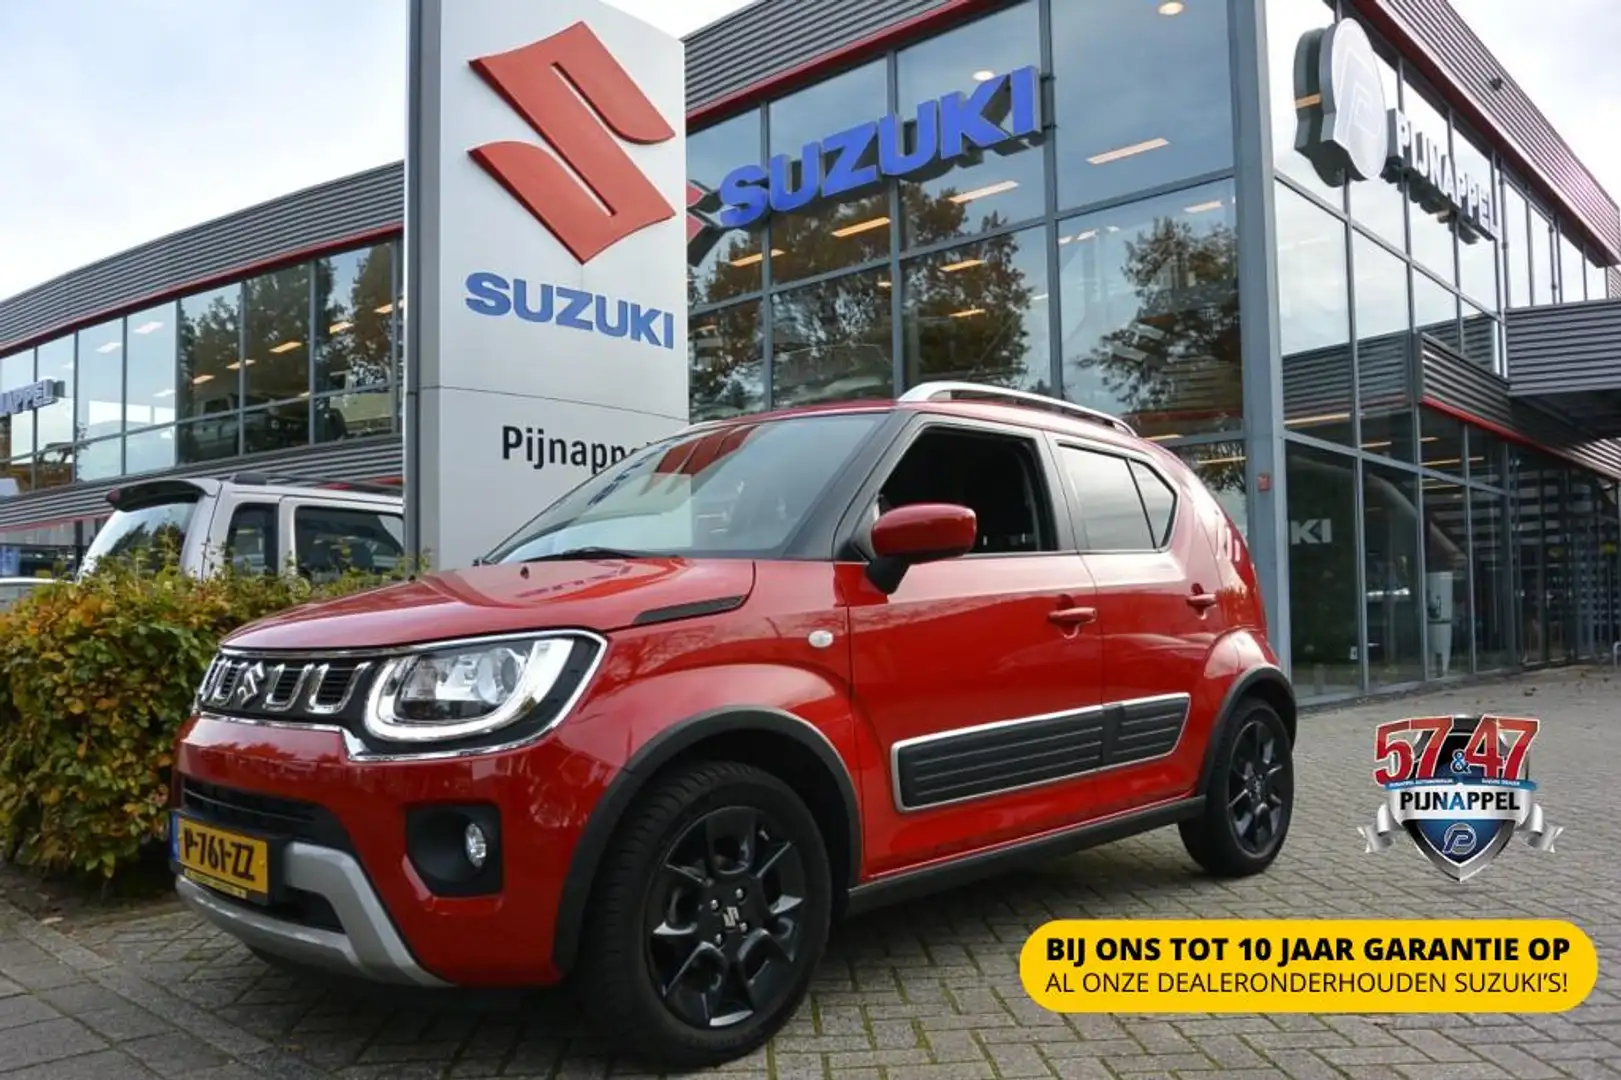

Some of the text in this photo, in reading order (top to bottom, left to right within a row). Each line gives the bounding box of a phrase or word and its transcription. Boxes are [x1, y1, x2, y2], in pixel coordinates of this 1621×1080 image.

[720, 66, 1041, 228] SUZUKI
[1387, 108, 1500, 240] PIJNAPPEL
[465, 272, 674, 350] SUZUKI
[502, 425, 651, 475] Pijnapp
[183, 827, 256, 882] P-761-ZZ
